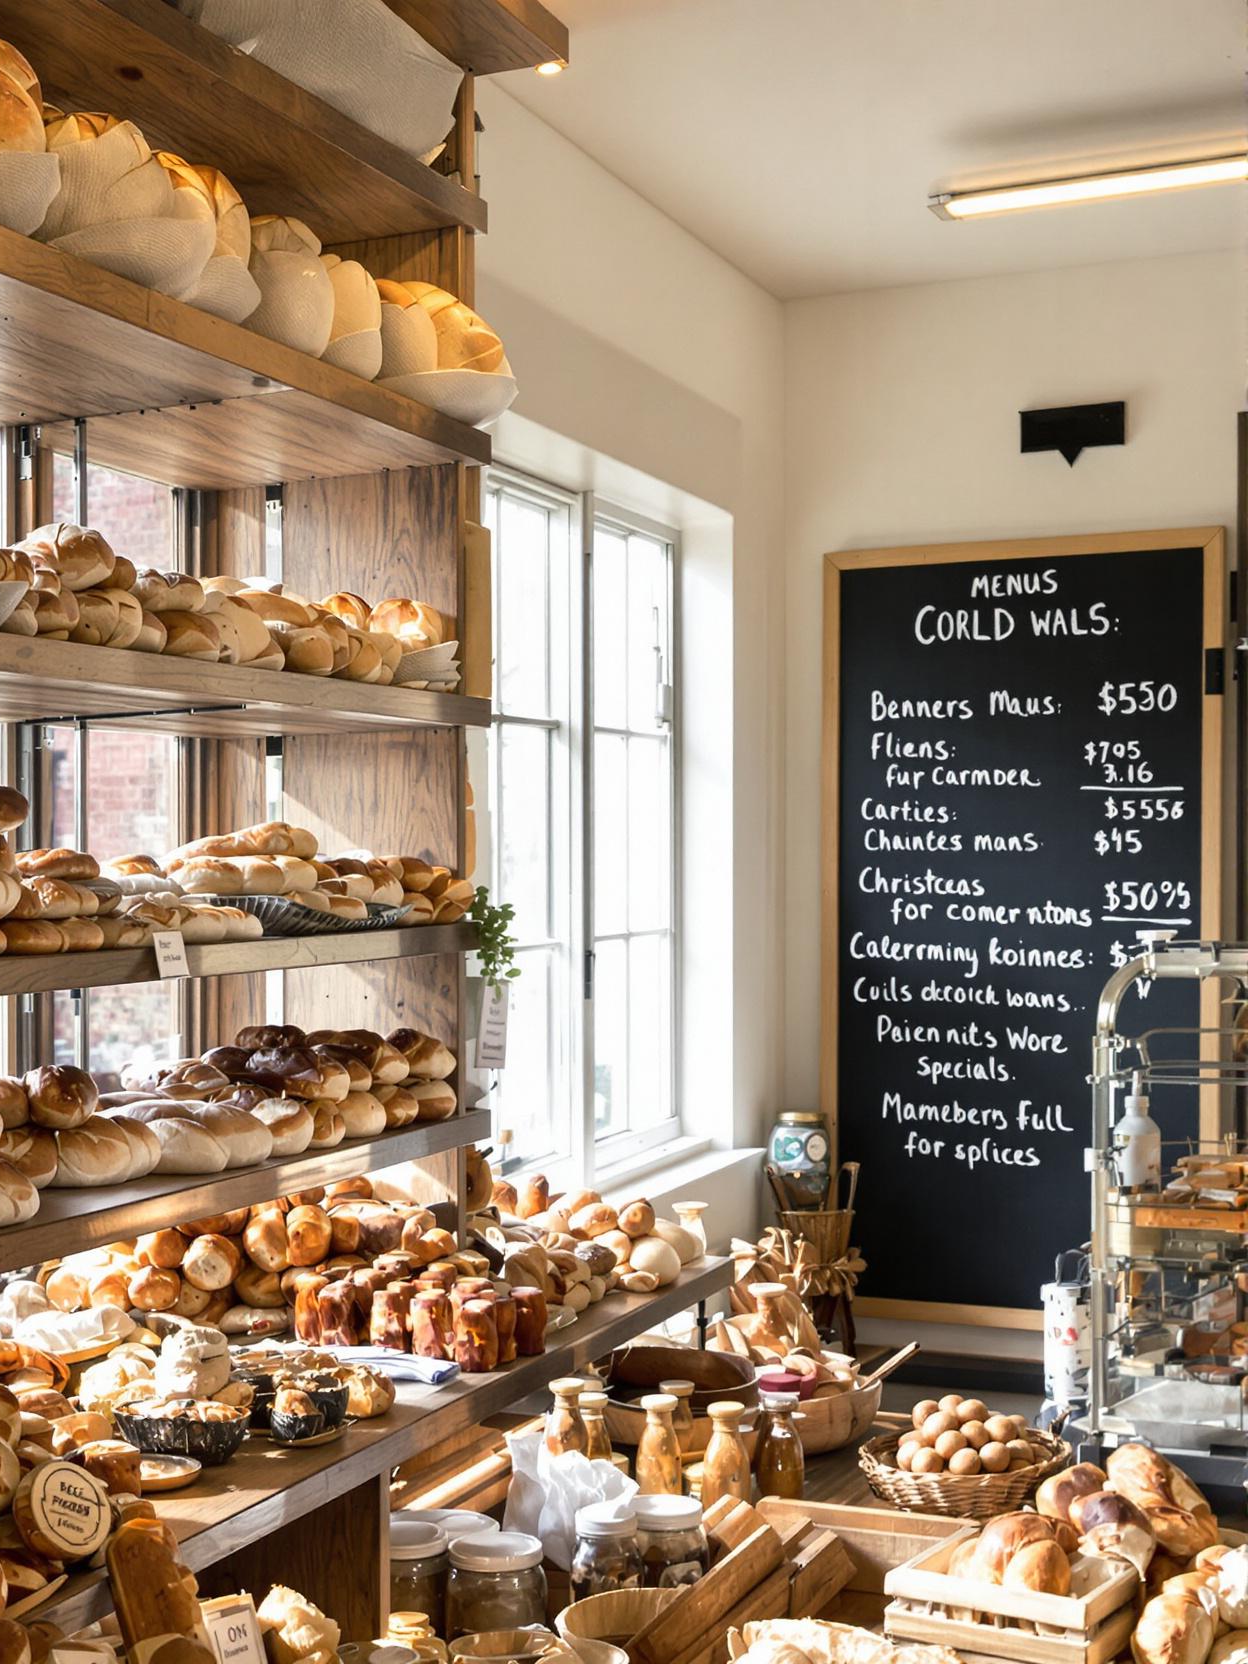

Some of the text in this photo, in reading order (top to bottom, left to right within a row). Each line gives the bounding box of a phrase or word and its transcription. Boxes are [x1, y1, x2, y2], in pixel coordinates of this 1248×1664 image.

[971, 569, 1059, 598] MENUS
[914, 602, 1122, 645] CORLD WALS:
[871, 690, 974, 721] Benners
[871, 732, 956, 760] Fliens:
[861, 798, 957, 824] Carties:
[1104, 796, 1185, 821] $5556
[1094, 827, 1143, 856] $45
[891, 898, 933, 925] for
[946, 903, 1021, 924] comer
[904, 1132, 1041, 1170] for splices
